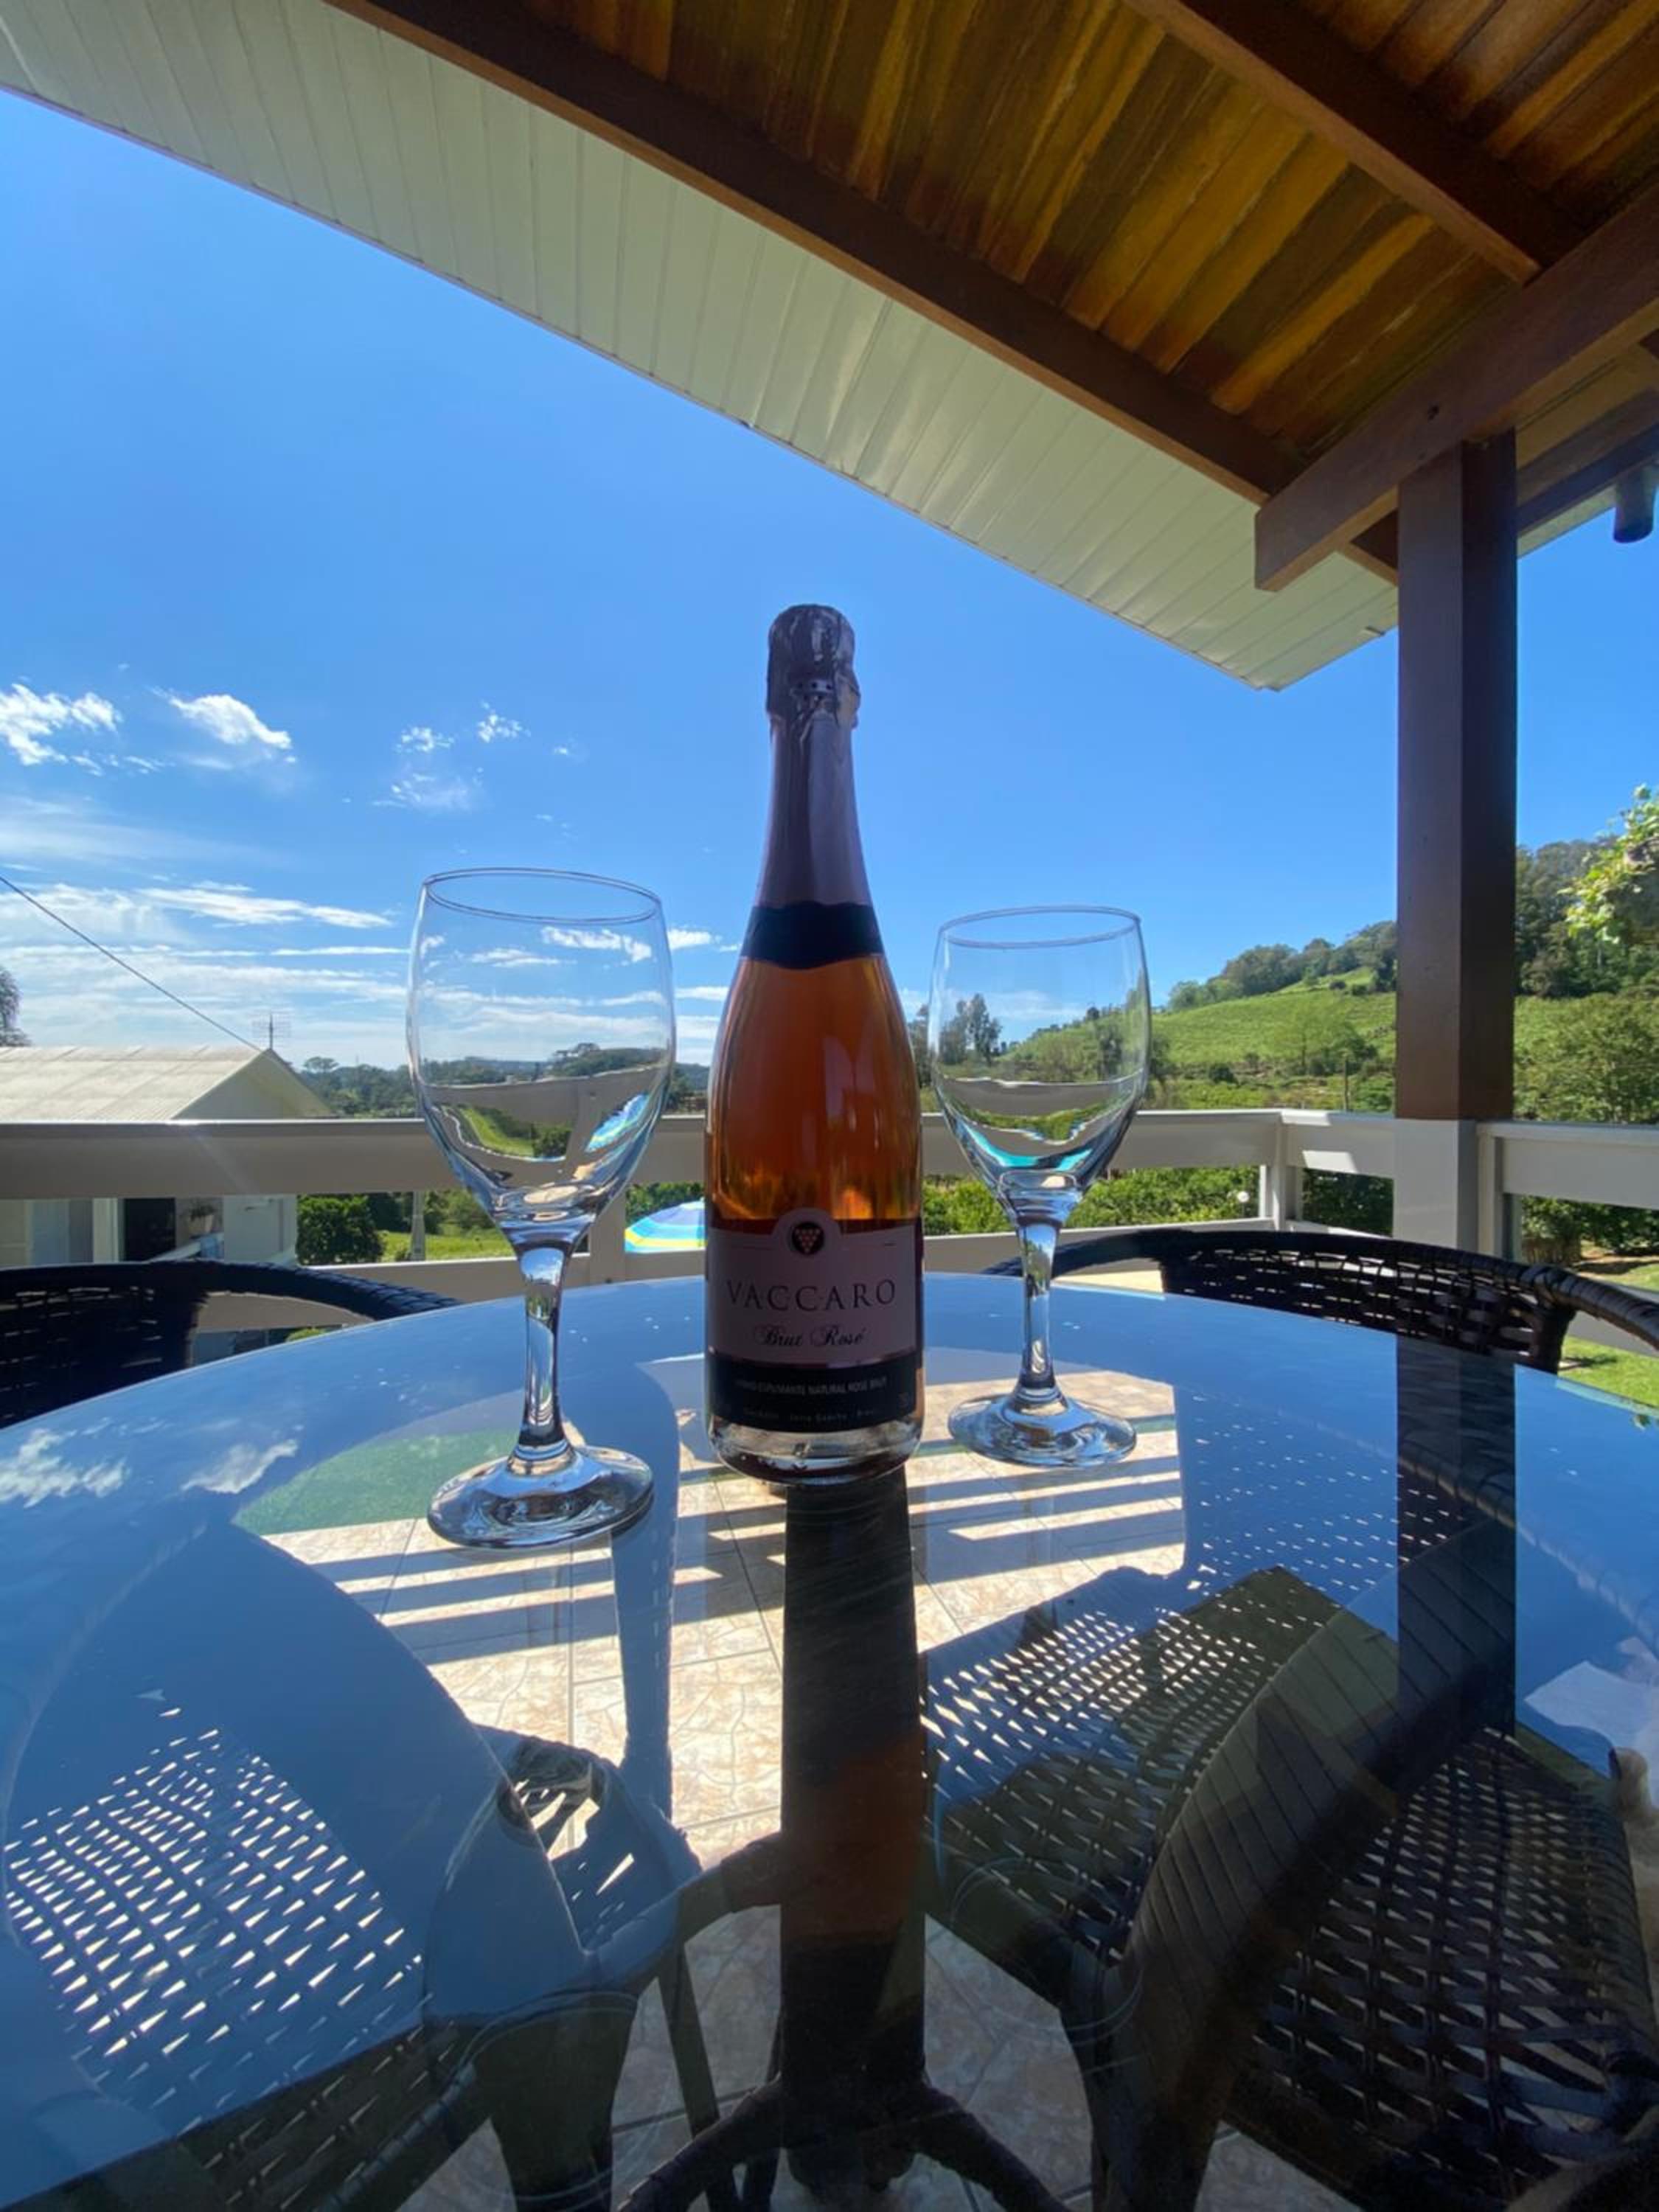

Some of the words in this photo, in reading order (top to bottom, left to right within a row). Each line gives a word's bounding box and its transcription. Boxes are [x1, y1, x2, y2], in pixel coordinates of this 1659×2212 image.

[727, 1279, 896, 1312] VACCARO
[754, 1324, 804, 1346] Brut
[811, 1324, 866, 1346] Rosé
